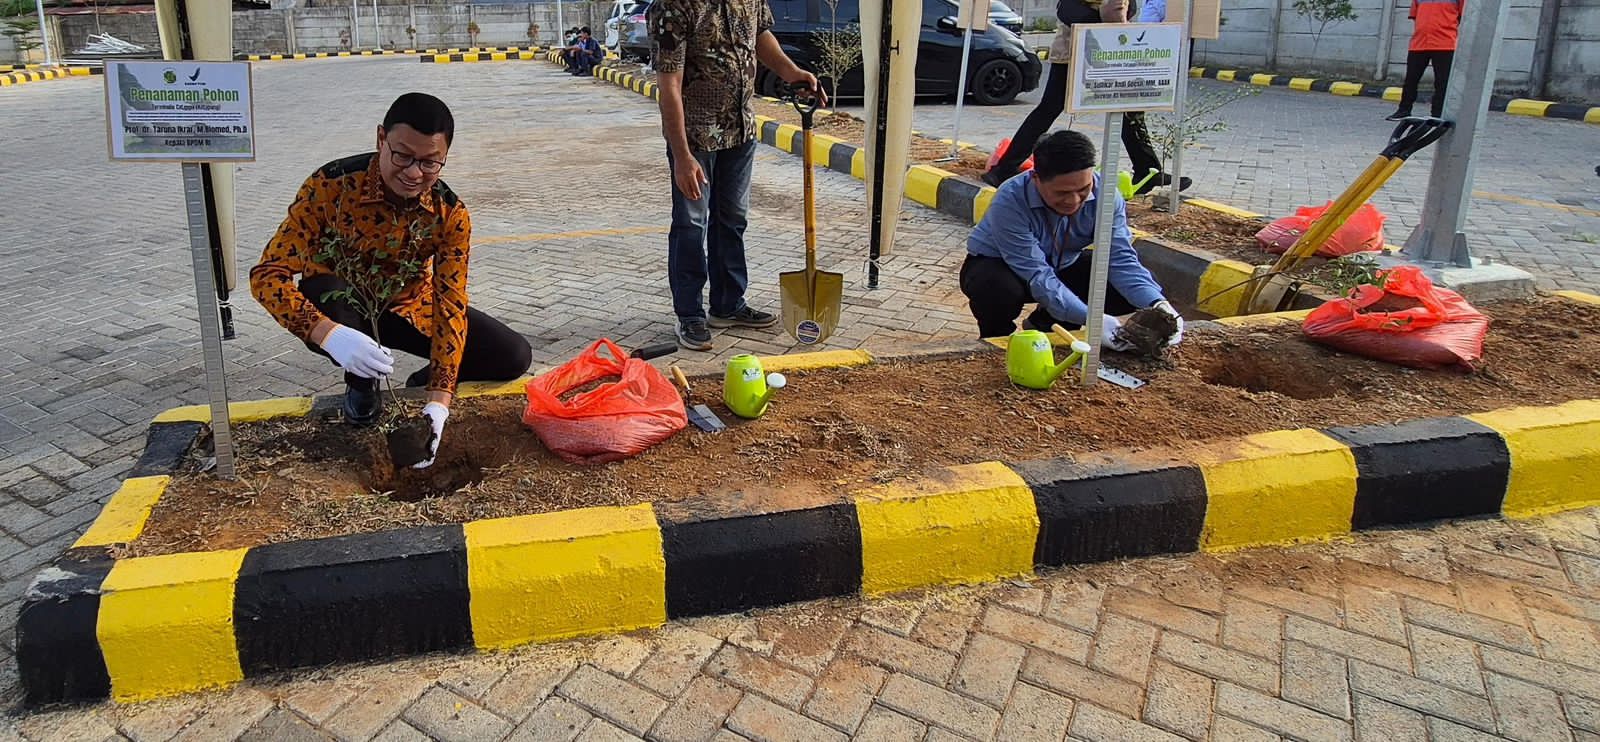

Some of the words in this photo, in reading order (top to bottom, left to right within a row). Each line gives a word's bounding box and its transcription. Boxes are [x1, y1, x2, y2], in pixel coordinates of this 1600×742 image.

[1091, 49, 1142, 61] Penanaman
[1145, 48, 1171, 59] Pohon
[130, 88, 200, 101] Penanaman
[204, 88, 239, 101] Pohon
[164, 139, 186, 147] Kepala
